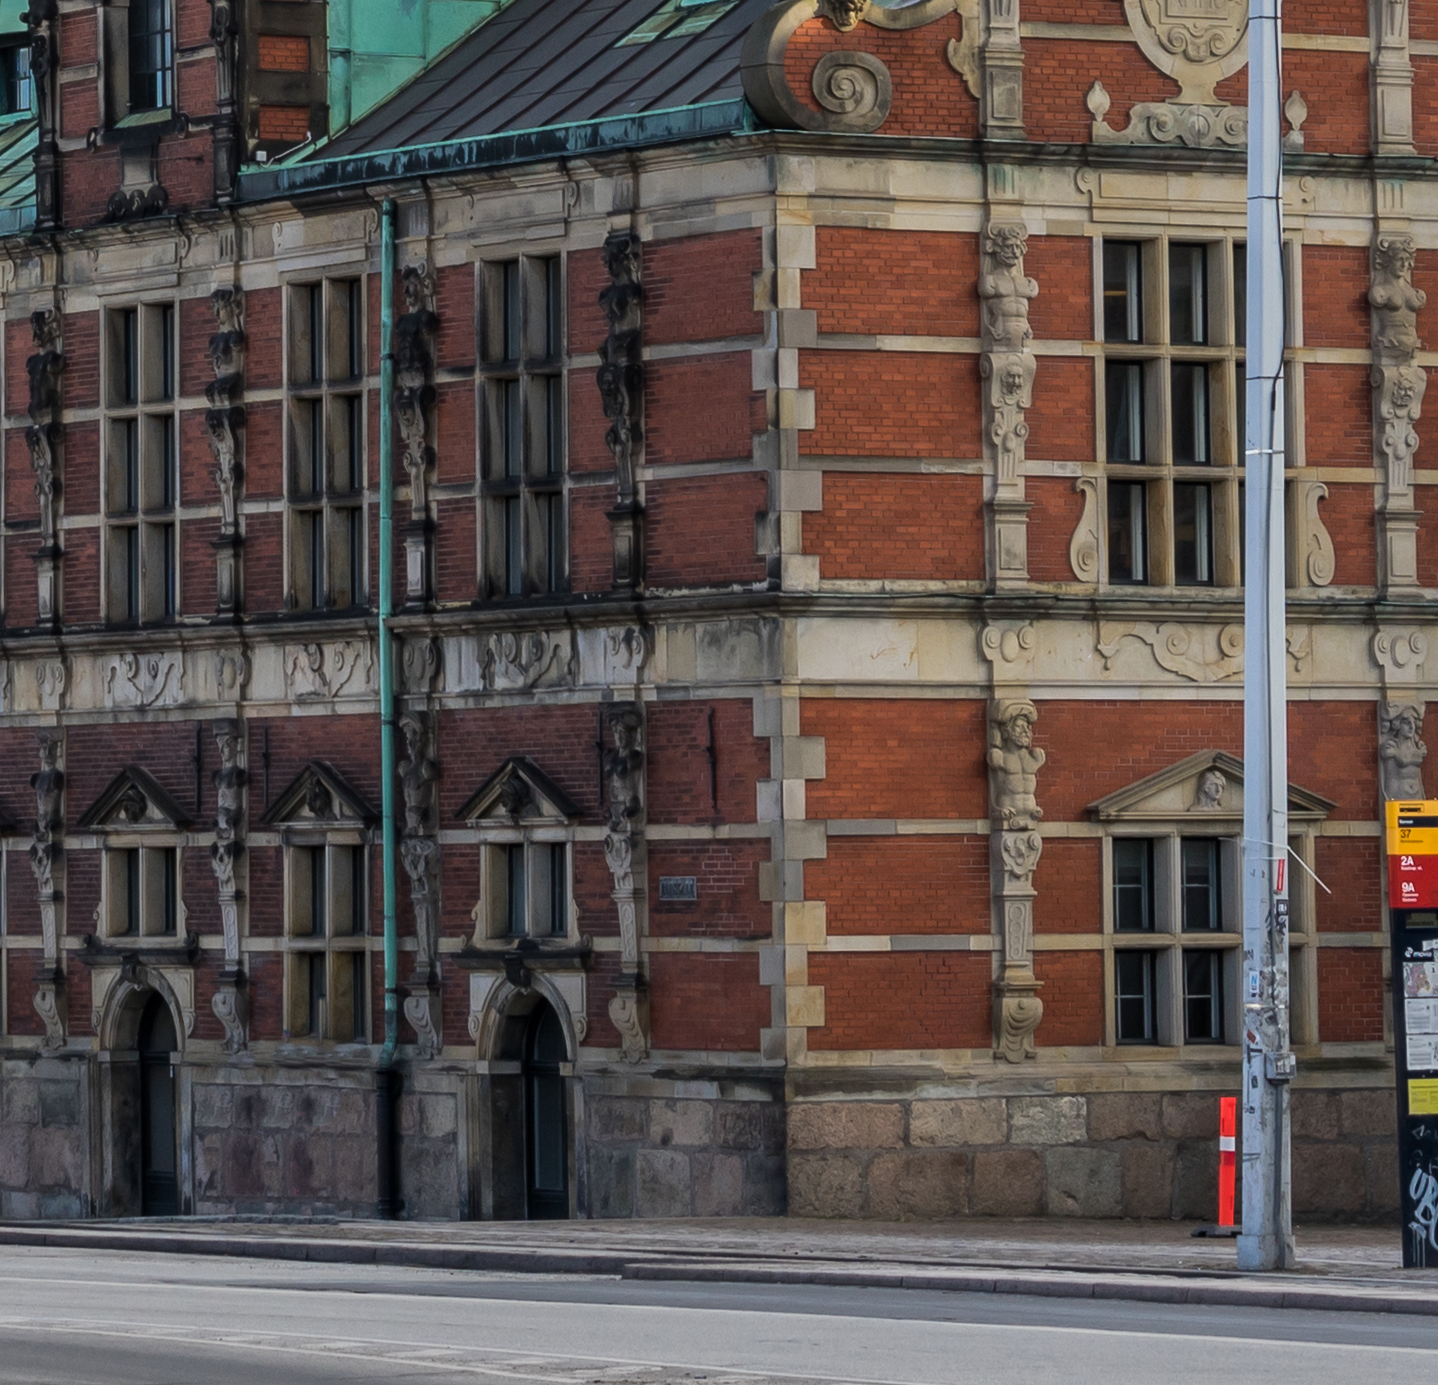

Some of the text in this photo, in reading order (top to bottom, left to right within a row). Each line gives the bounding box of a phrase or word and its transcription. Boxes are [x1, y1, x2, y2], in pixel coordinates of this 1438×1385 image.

[1400, 829, 1412, 839] 37
[1400, 855, 1414, 866] 2A
[1401, 881, 1415, 892] 9A
